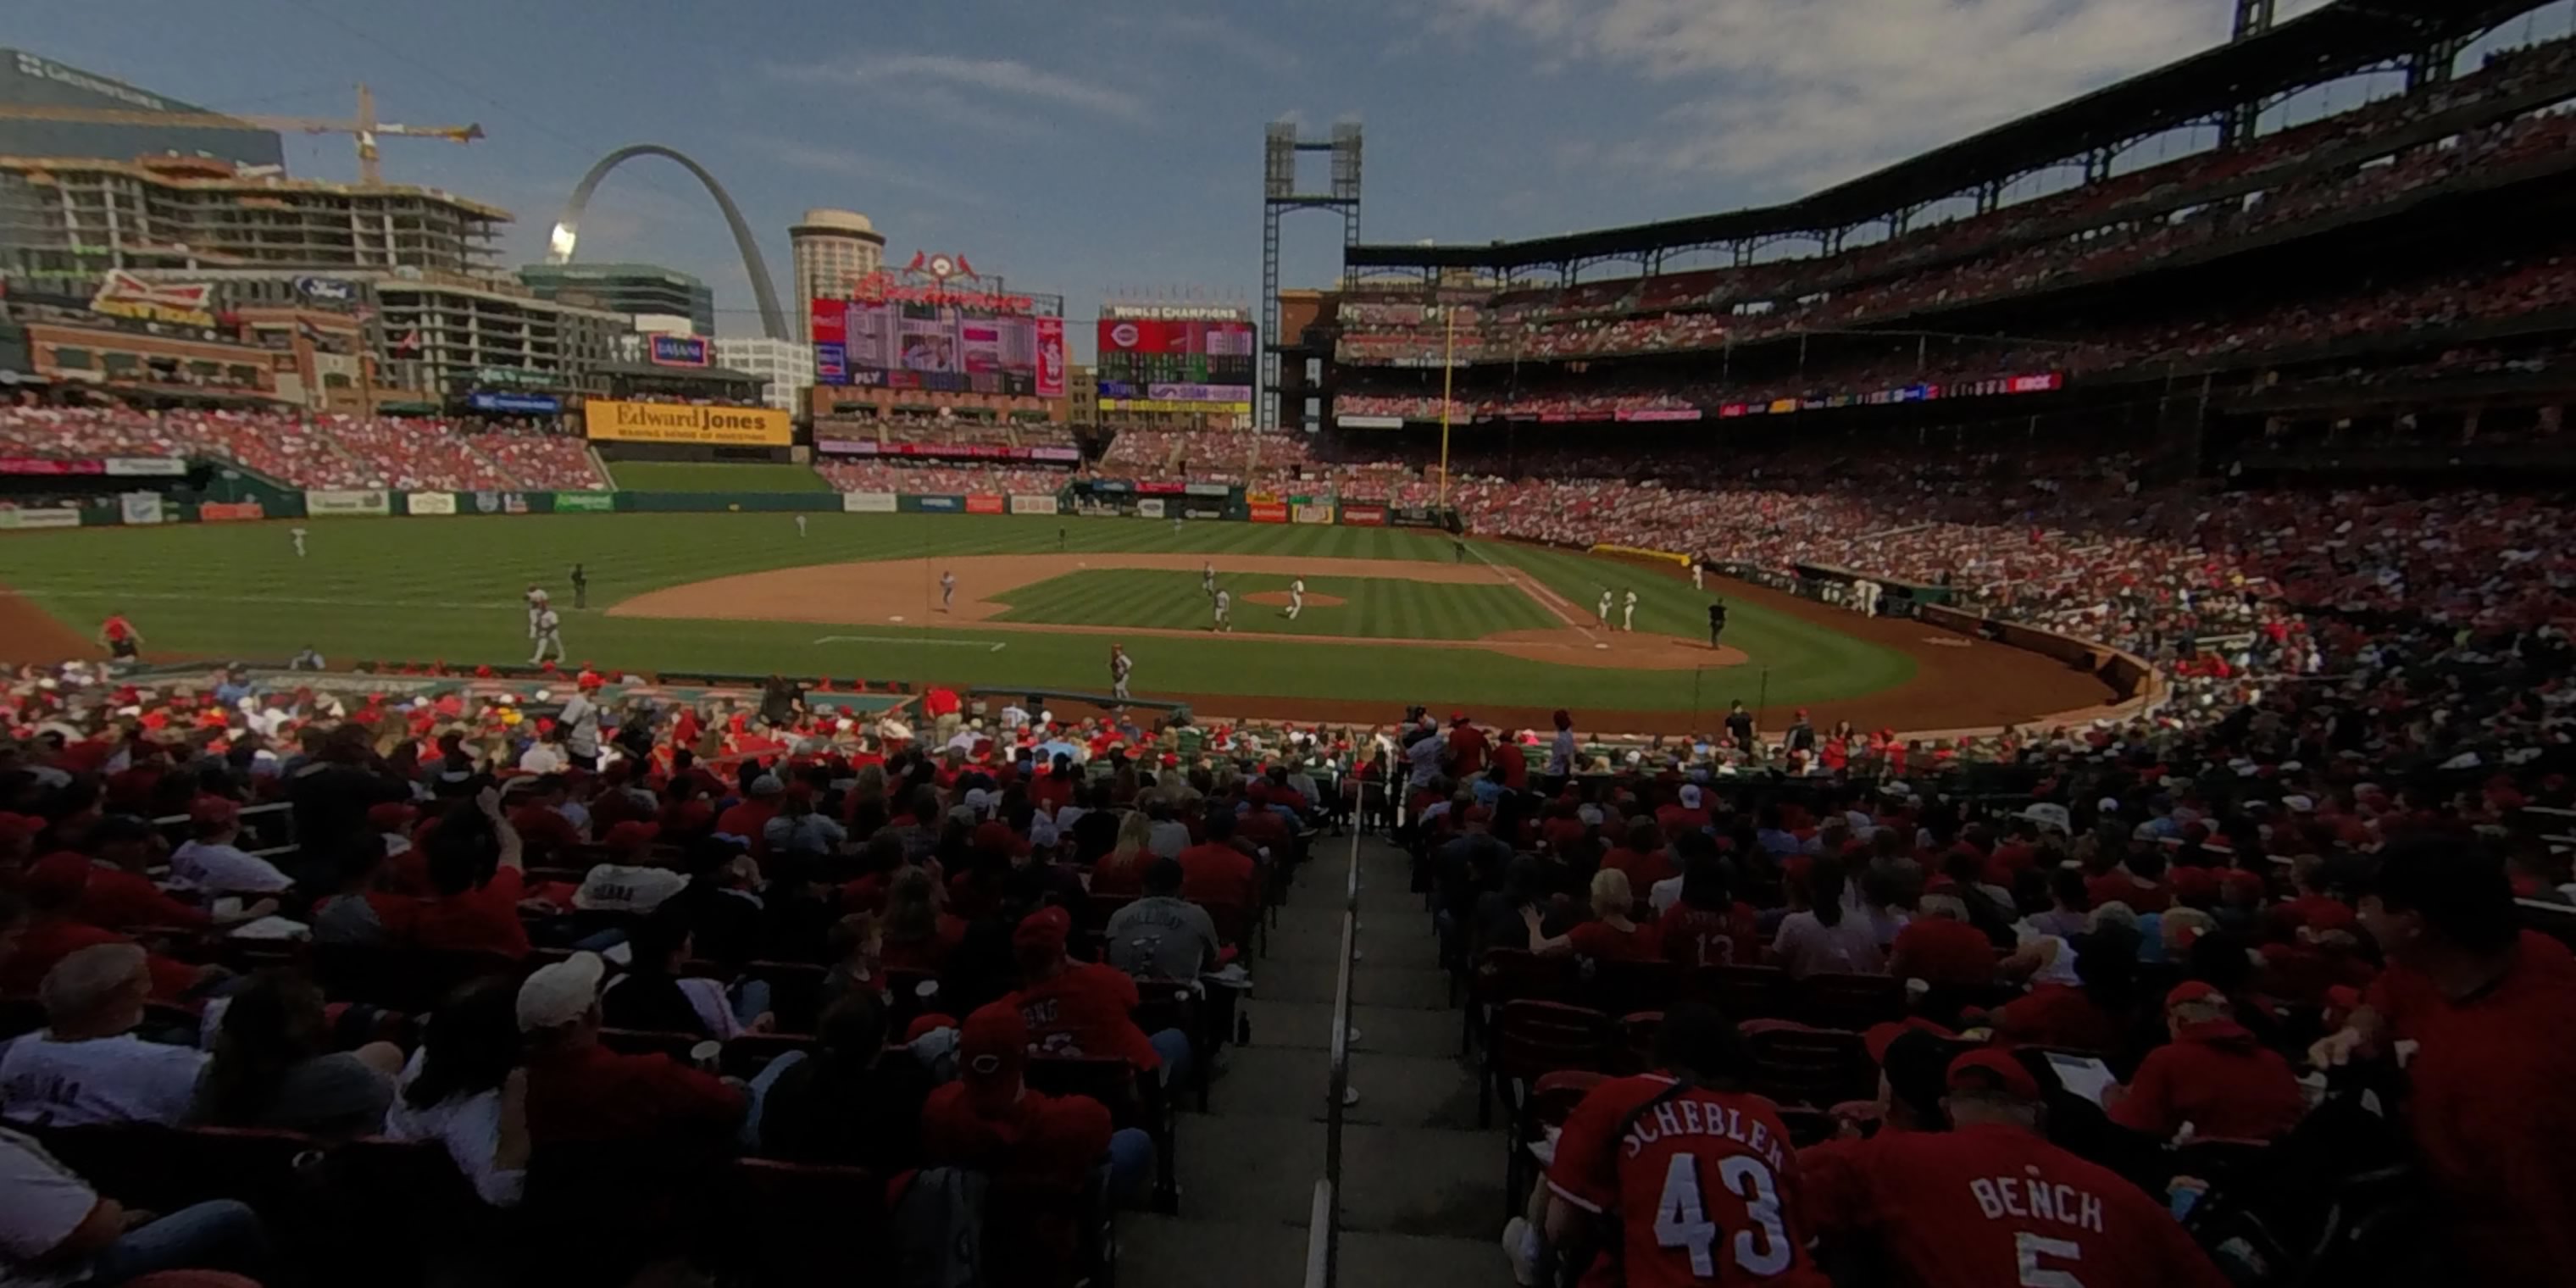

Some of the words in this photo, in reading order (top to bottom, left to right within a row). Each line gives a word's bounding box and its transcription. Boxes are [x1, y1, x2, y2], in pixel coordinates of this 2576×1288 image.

[1114, 306, 1160, 319] WORLD
[1162, 306, 1237, 319] CHAMPIONS
[617, 404, 700, 428] Edward
[702, 409, 767, 432] Jones
[1696, 932, 1735, 967] 13
[1623, 1099, 1784, 1174] SCHEBLER
[1652, 1152, 1792, 1276] 43
[1968, 1175, 2103, 1234] BENCH
